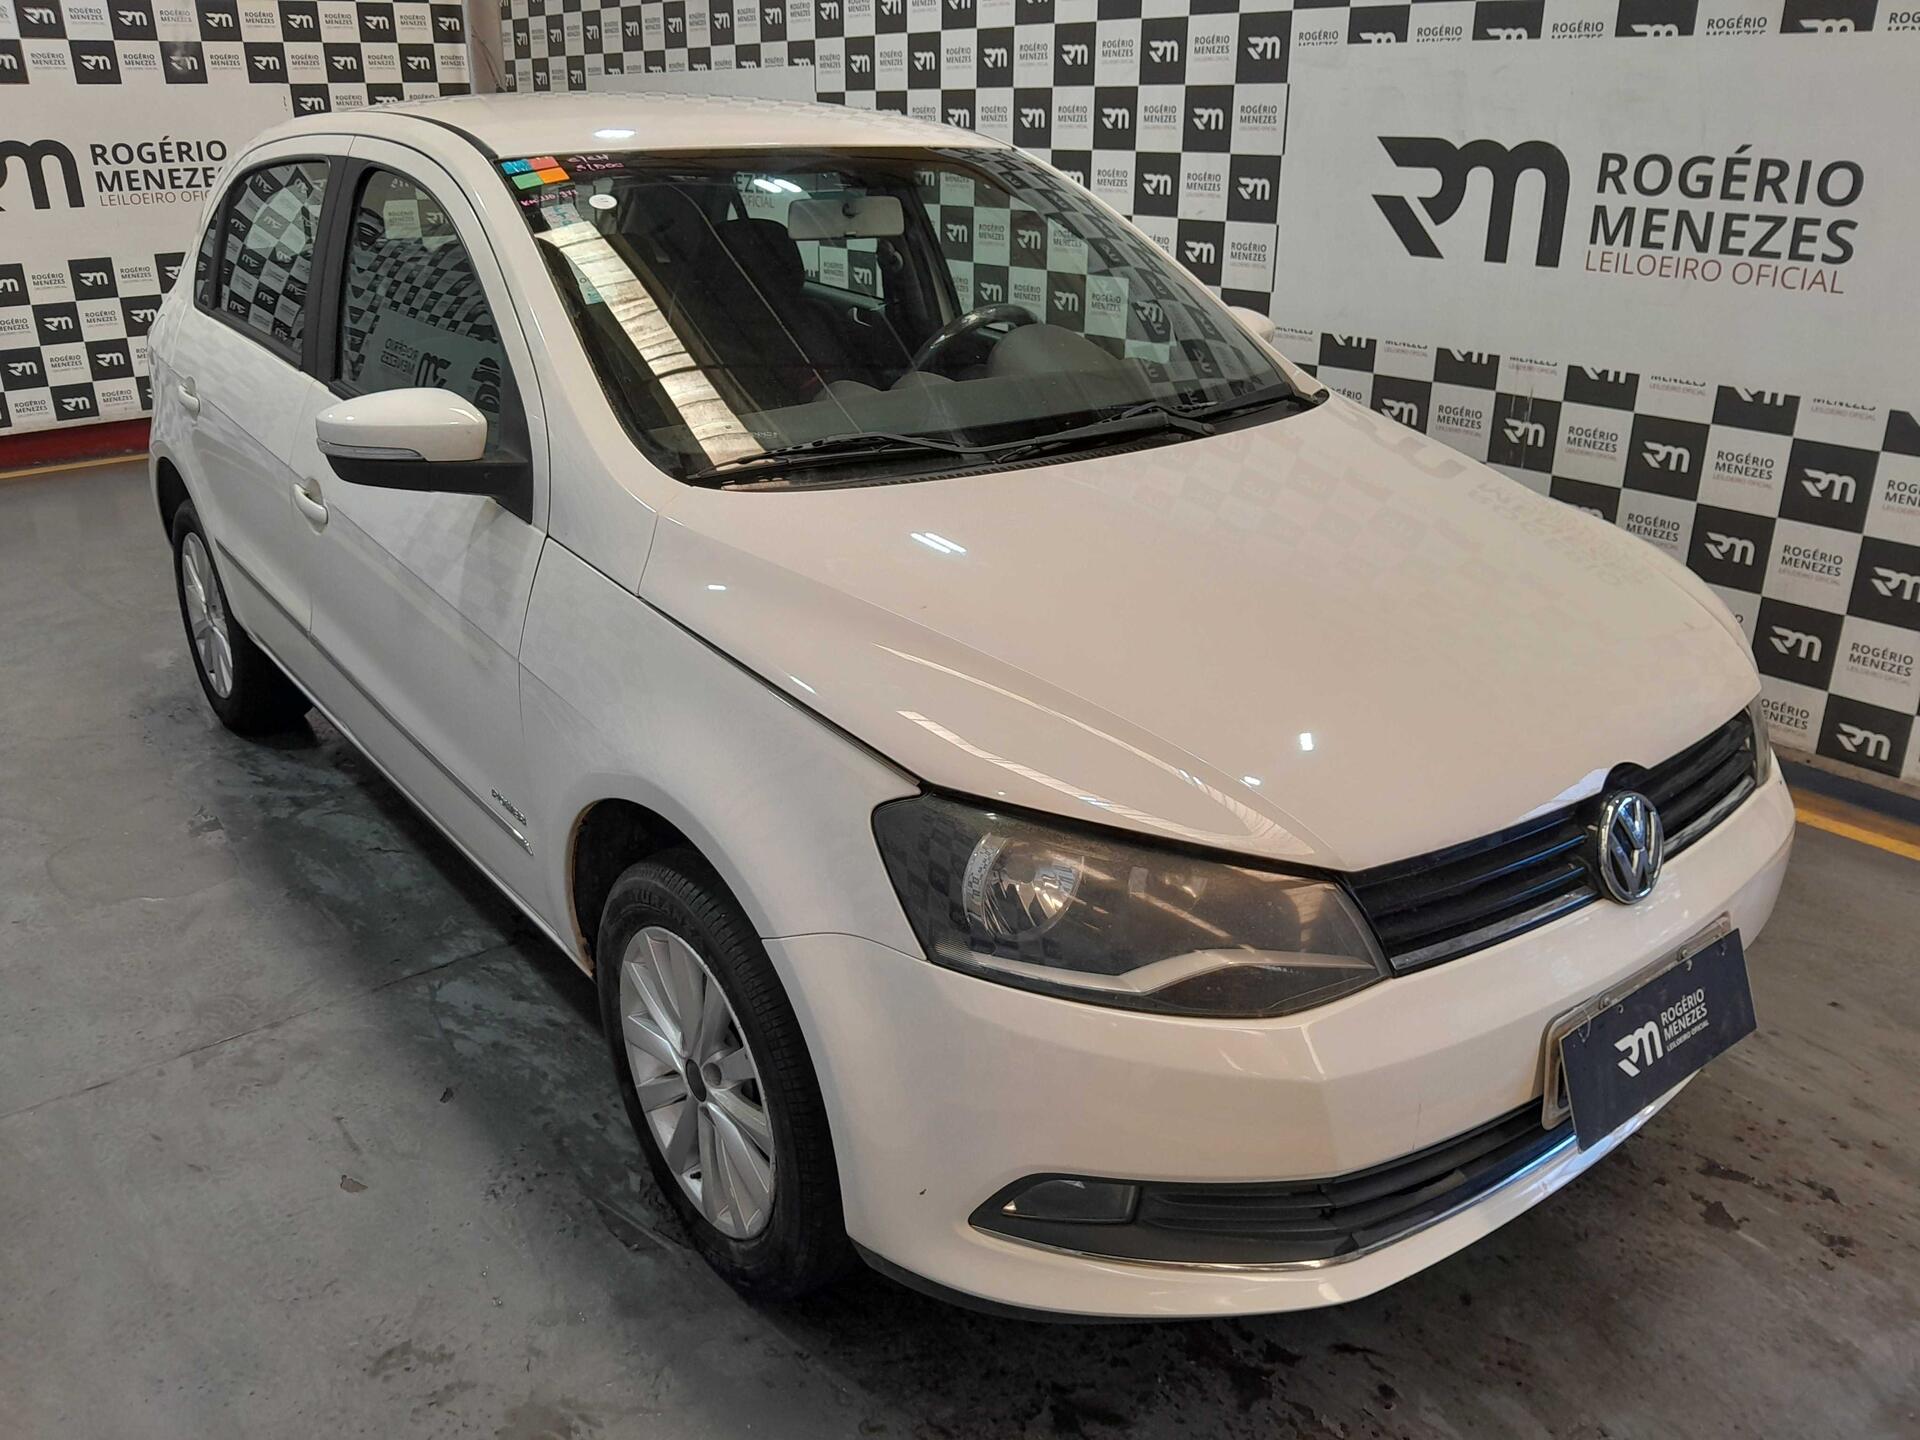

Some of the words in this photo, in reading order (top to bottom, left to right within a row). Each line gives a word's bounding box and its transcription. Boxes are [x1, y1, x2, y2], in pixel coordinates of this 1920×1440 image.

[1417, 26, 1463, 37] ROGÉRIO
[1552, 20, 1604, 33] ROGÉRIO
[1707, 15, 1767, 29] ROGÉRIO
[90, 136, 227, 165] ROGÉRIO
[95, 167, 223, 192] MENEZE
[1596, 144, 1865, 208] ROGÉRIO
[99, 191, 176, 207] LEILOEIRO
[1588, 204, 1860, 265] MENEZES
[1585, 250, 1722, 283] LEILOEIRO
[1732, 260, 1846, 295] OFICIAL
[1438, 404, 1483, 419] ROGÉRIO
[1437, 415, 1482, 430] MENEZES
[1568, 425, 1619, 442] ROGÉRIO
[1567, 436, 1618, 453] MENEZES
[1717, 450, 1775, 469] ROGÉRIO
[1714, 461, 1773, 480] MENEZES
[1627, 512, 1680, 531] ROGÉRIO
[1626, 523, 1679, 542] MENEZES
[1783, 544, 1843, 566] ROGÉRIO
[1780, 555, 1842, 577] MENEZES
[1851, 642, 1914, 666] ROGÉRIO
[1849, 653, 1913, 678] MENEZES
[1760, 698, 1810, 720] OGÉRIO
[1763, 710, 1808, 730] ENEZES
[1661, 988, 1704, 1026] ROGÉRIO
[1663, 1002, 1708, 1042] MENEZES
